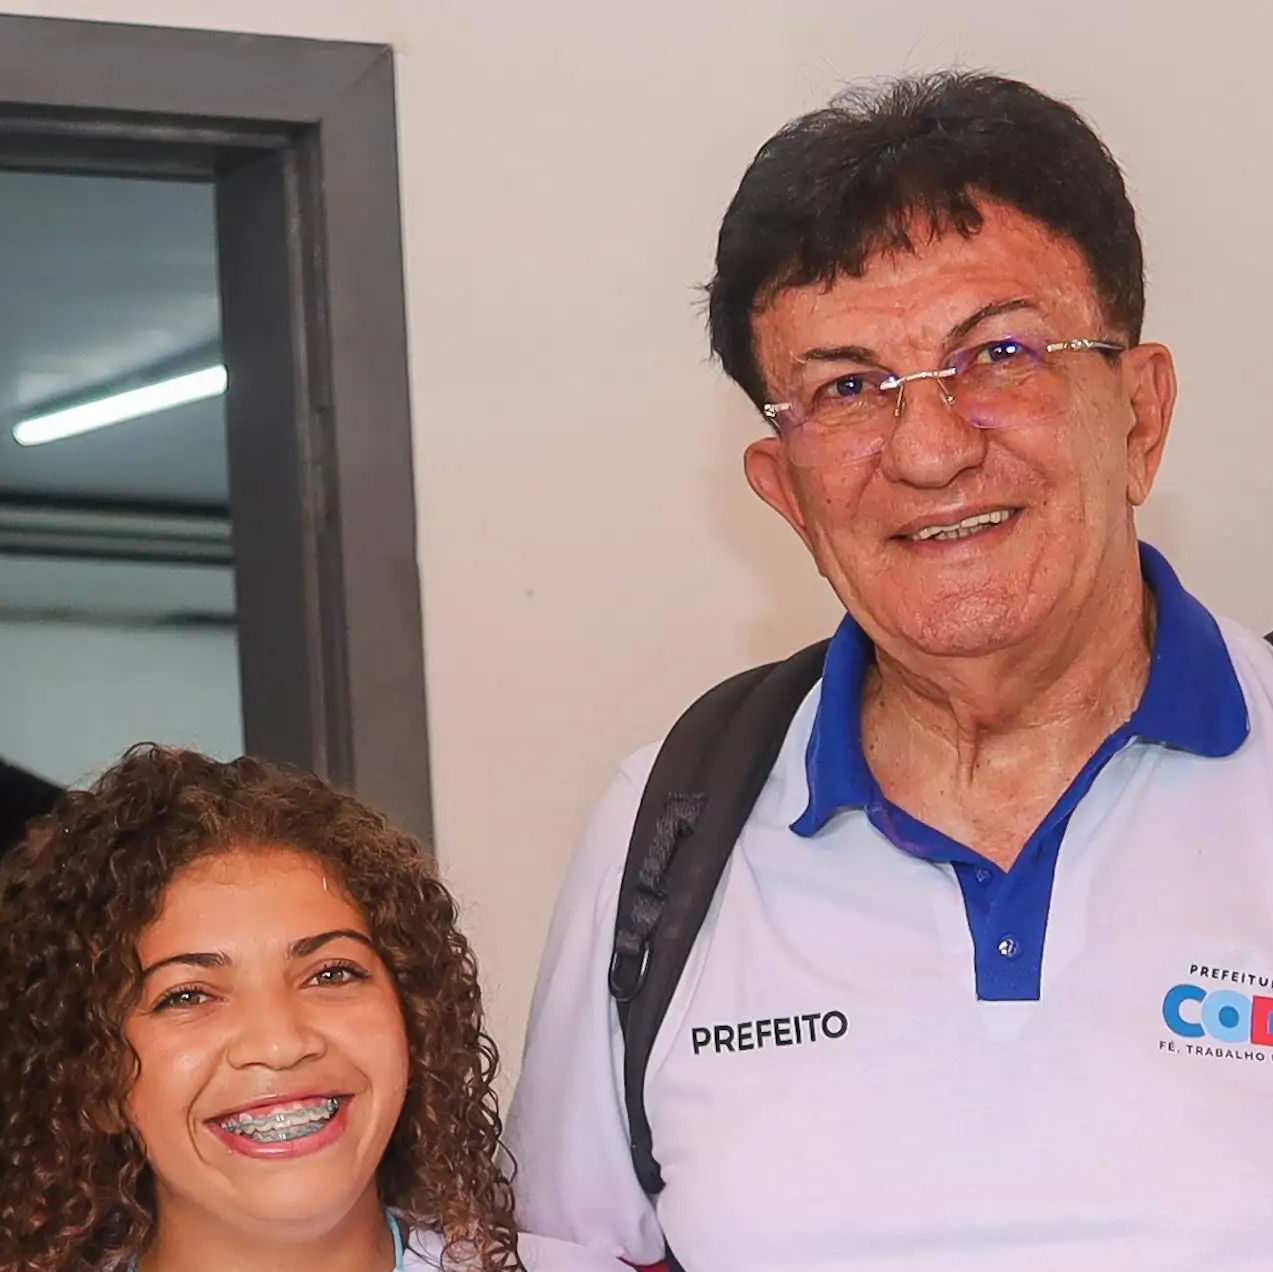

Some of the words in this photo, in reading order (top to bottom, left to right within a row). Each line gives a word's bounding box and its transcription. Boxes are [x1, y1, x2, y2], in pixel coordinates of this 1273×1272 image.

[691, 1010, 849, 1055] PREFEITO
[1159, 1040, 1181, 1053] FÉ,
[1186, 1044, 1266, 1063] TRABALHO
